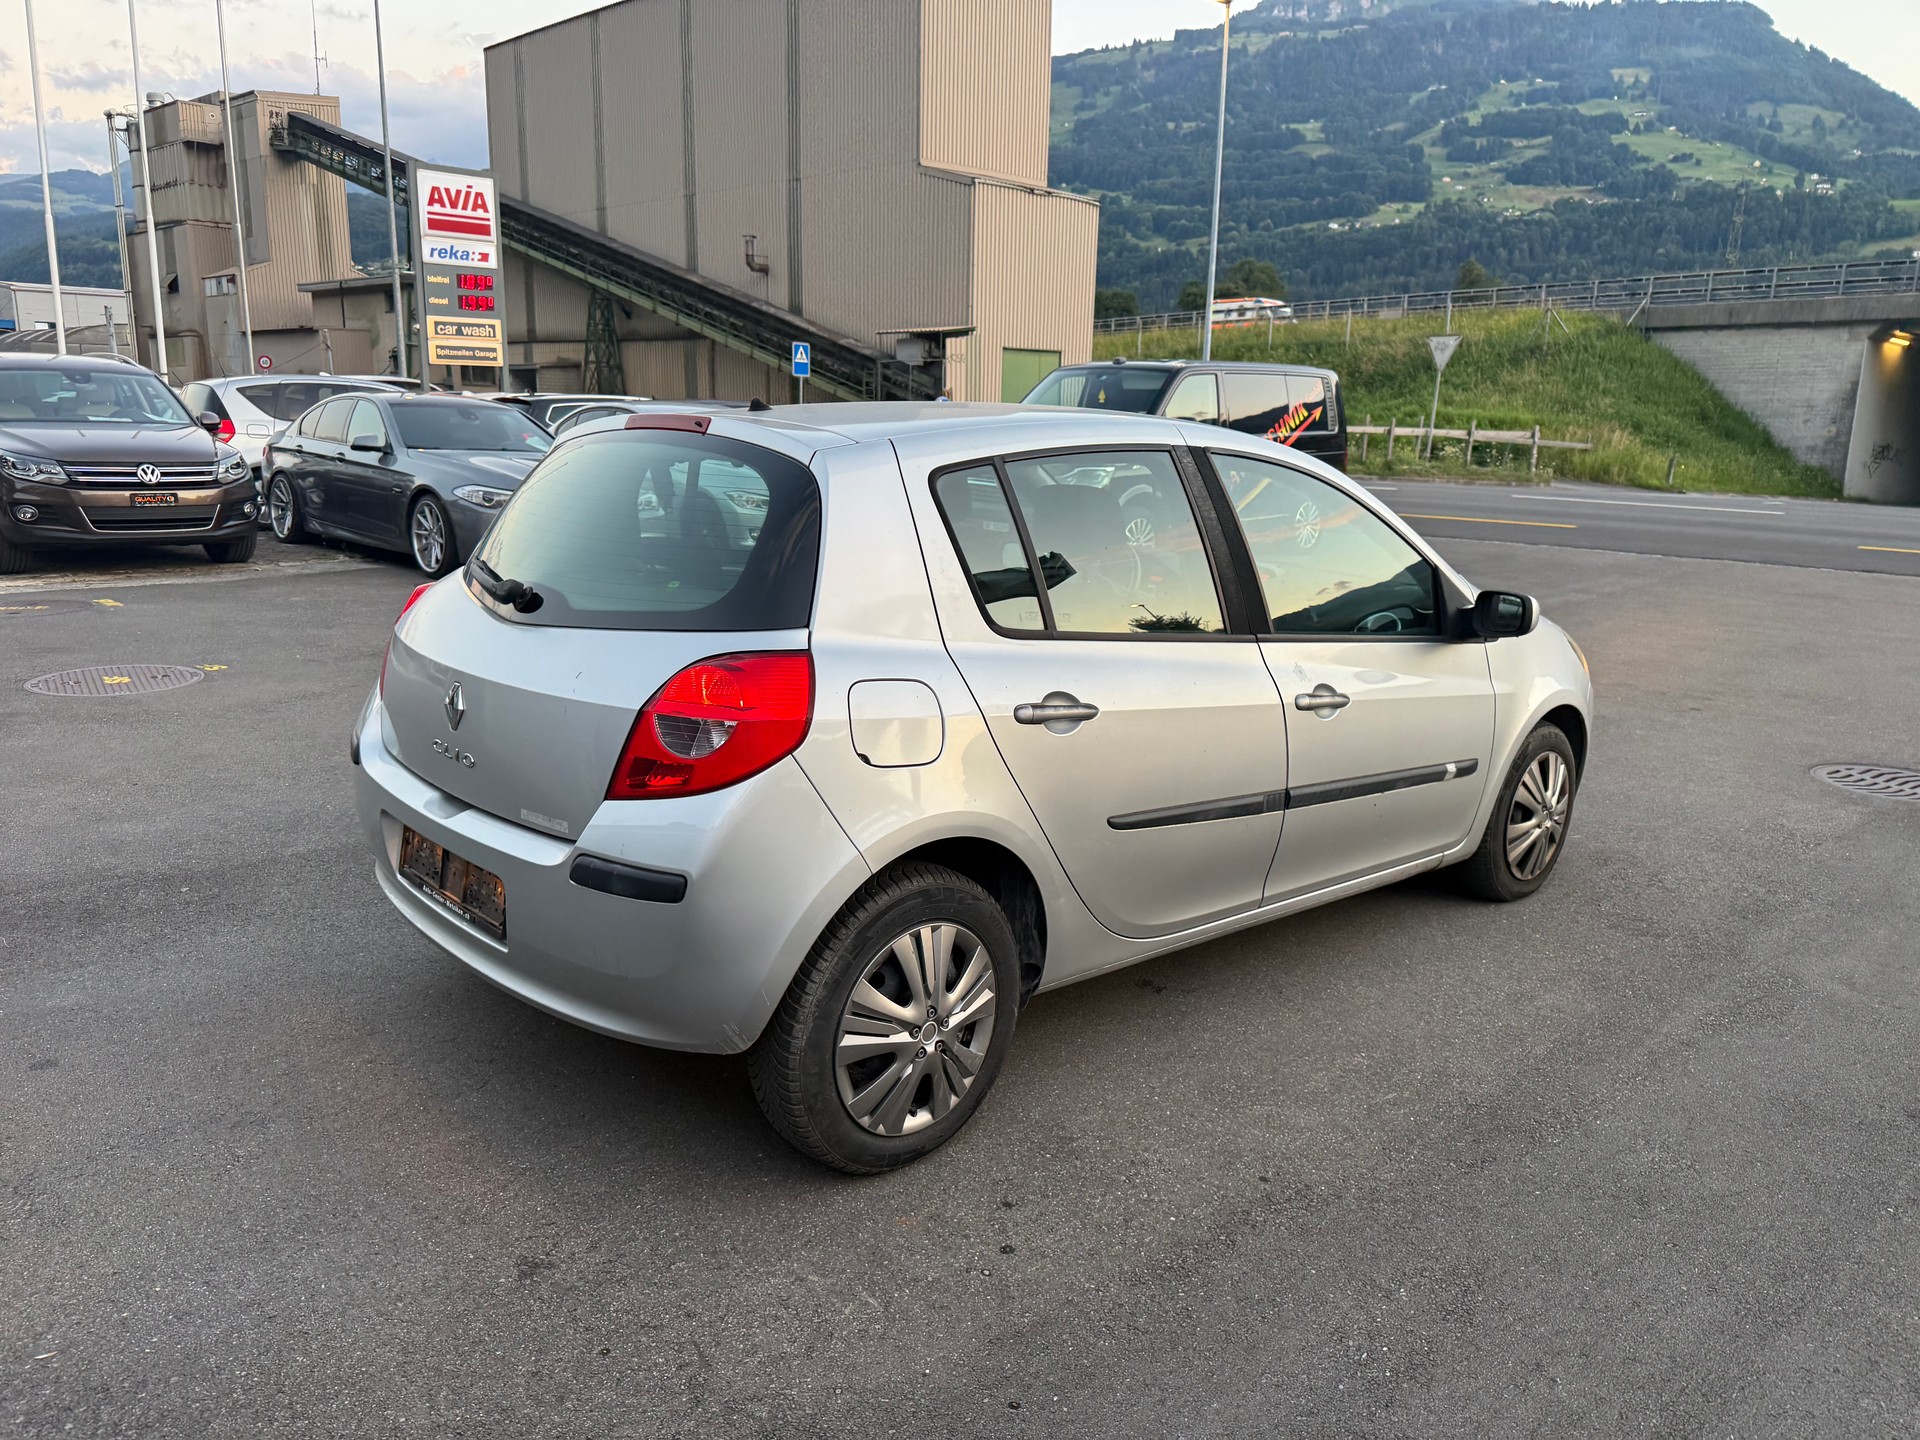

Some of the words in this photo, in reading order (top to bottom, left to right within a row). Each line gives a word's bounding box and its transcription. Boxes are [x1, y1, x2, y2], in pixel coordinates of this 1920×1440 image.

[428, 297, 449, 305] diesel
[437, 324, 458, 335] car
[461, 325, 494, 337] wash
[474, 349, 498, 359] Garage
[433, 738, 475, 768] CLIO
